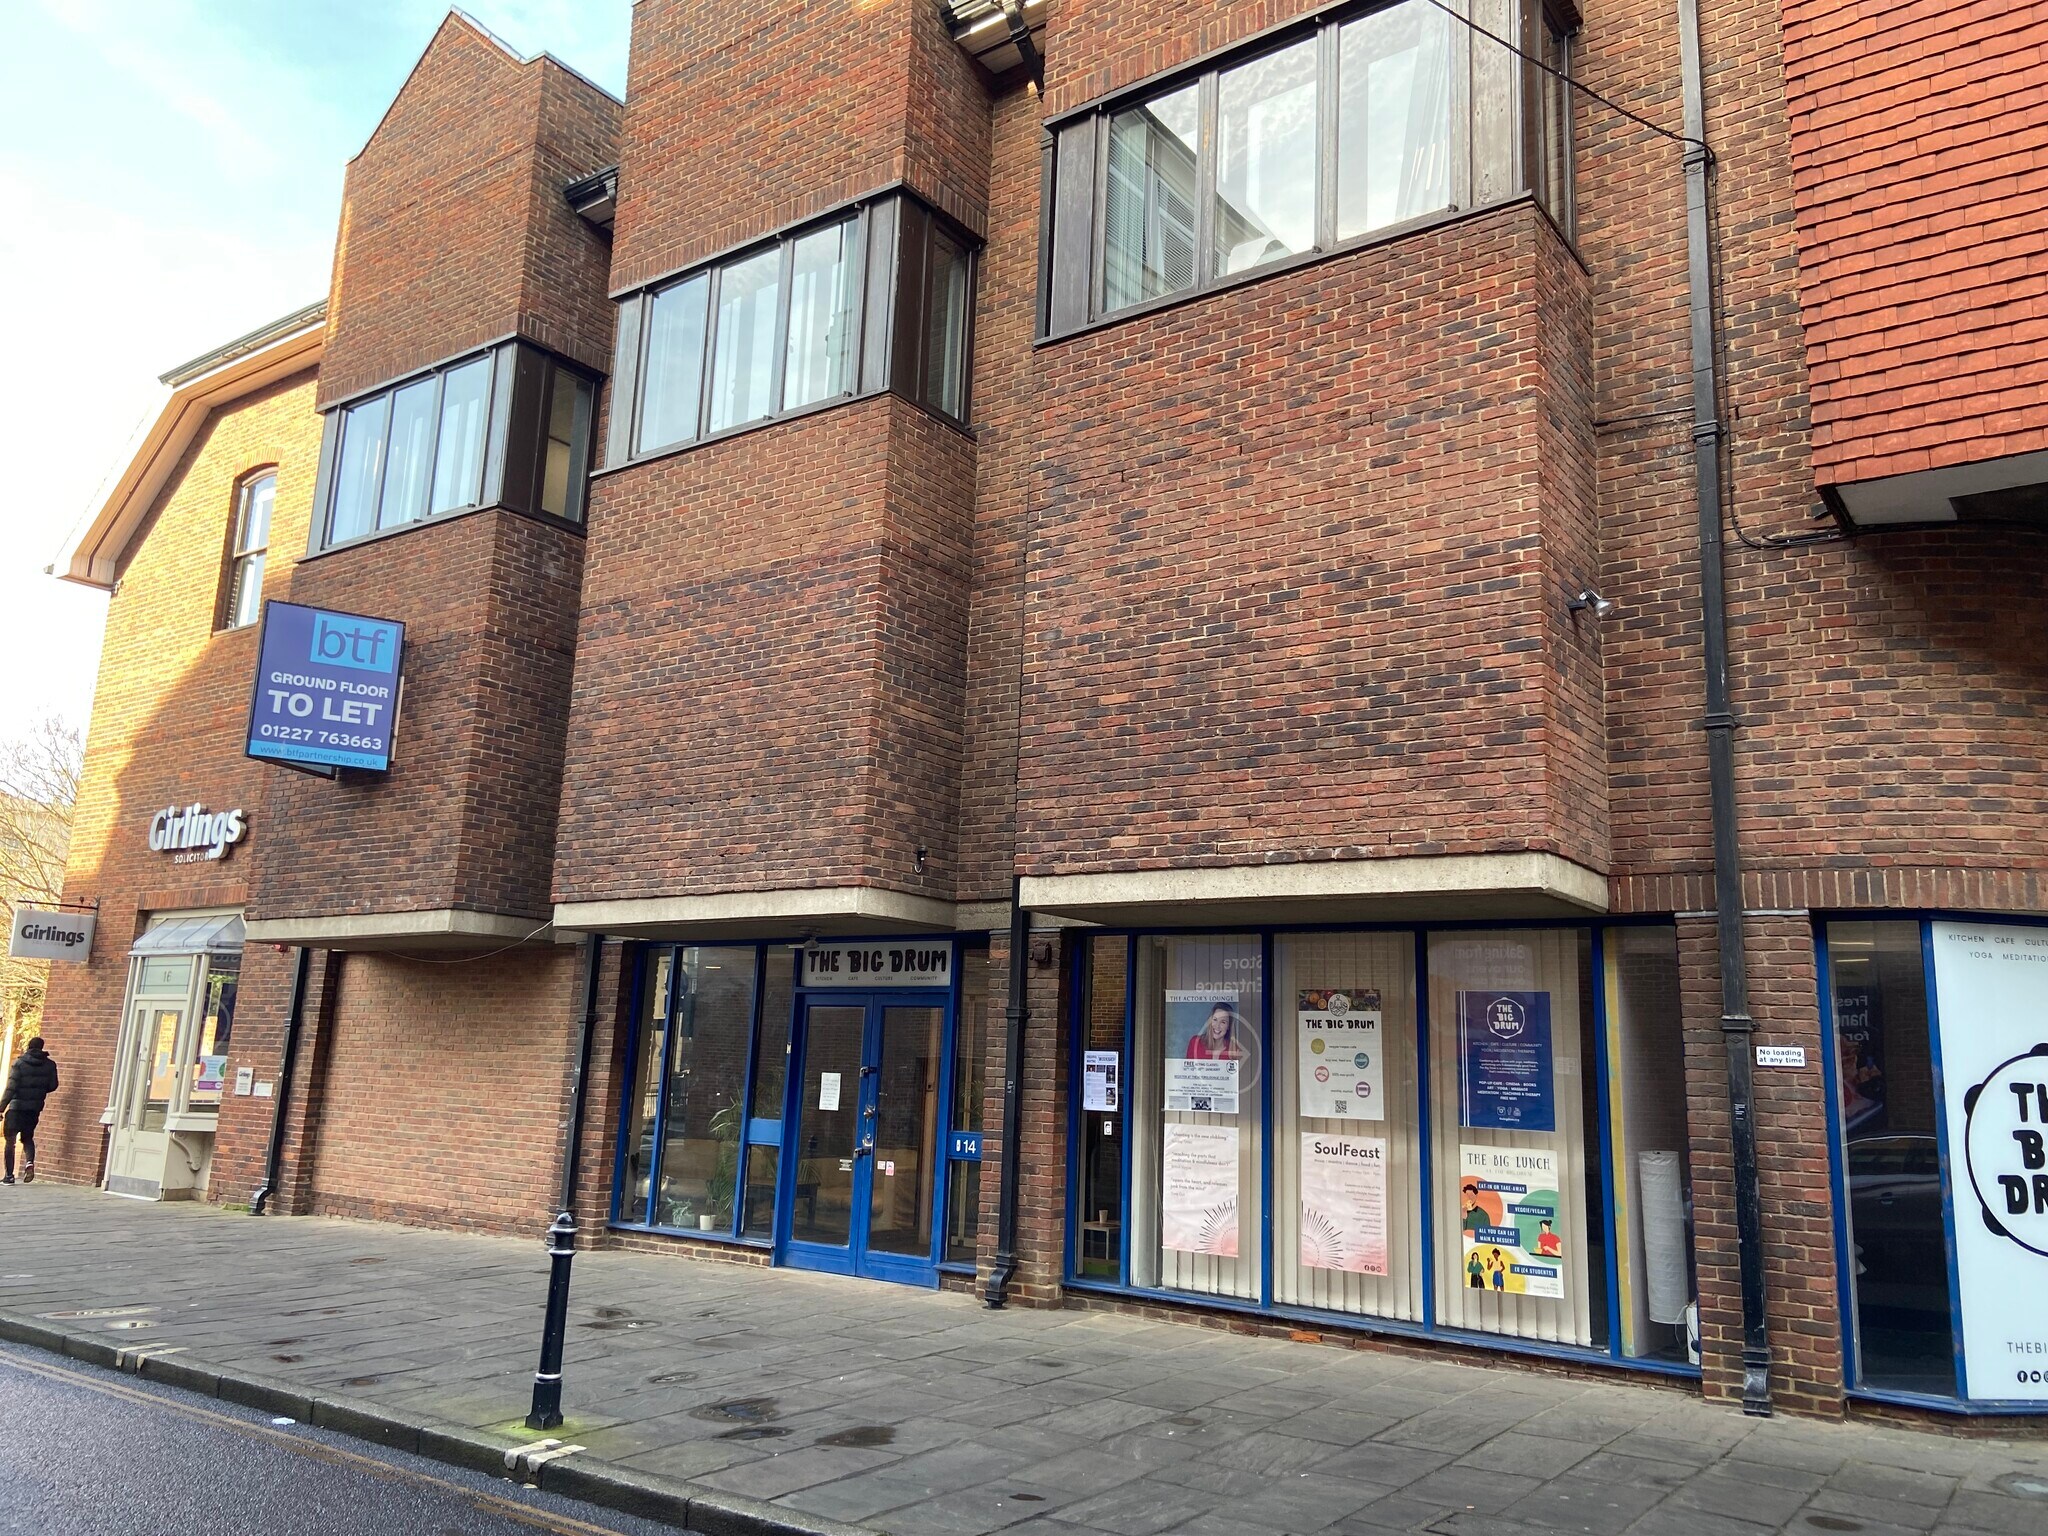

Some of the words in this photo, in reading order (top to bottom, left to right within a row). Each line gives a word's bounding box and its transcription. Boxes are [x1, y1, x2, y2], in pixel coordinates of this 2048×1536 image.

[317, 620, 388, 664] btf
[271, 672, 337, 690] GROUND
[340, 682, 389, 698] FLOOR
[268, 689, 314, 717] TO
[322, 697, 383, 726] LET
[260, 724, 313, 741] 01227
[318, 731, 382, 749] 763663
[260, 745, 377, 767] www.btfpartnership.co.uk
[150, 802, 243, 859] Girlings
[174, 852, 212, 864] SOLICITOR
[21, 924, 85, 947] Girlings
[1948, 934, 1985, 943] KITCHEN
[808, 951, 840, 972] THE
[847, 950, 884, 973] BIG
[889, 949, 947, 973] DRUM
[2002, 954, 2048, 962] MEDITATIO
[1496, 1004, 1512, 1013] THE
[1306, 1020, 1322, 1029] THE
[1326, 1020, 1344, 1029] BIG
[1346, 1020, 1374, 1029] DRUM
[1496, 1013, 1514, 1021] BIG
[1493, 1021, 1519, 1030] DRUM
[1773, 1049, 1801, 1057] loading
[963, 1140, 976, 1154] 14
[1314, 1141, 1380, 1159] SoulFeast
[1467, 1153, 1486, 1166] THE
[1494, 1155, 1510, 1167] BIG
[1516, 1156, 1550, 1170] LUNCH
[1530, 1268, 1554, 1276] STUDENTS)
